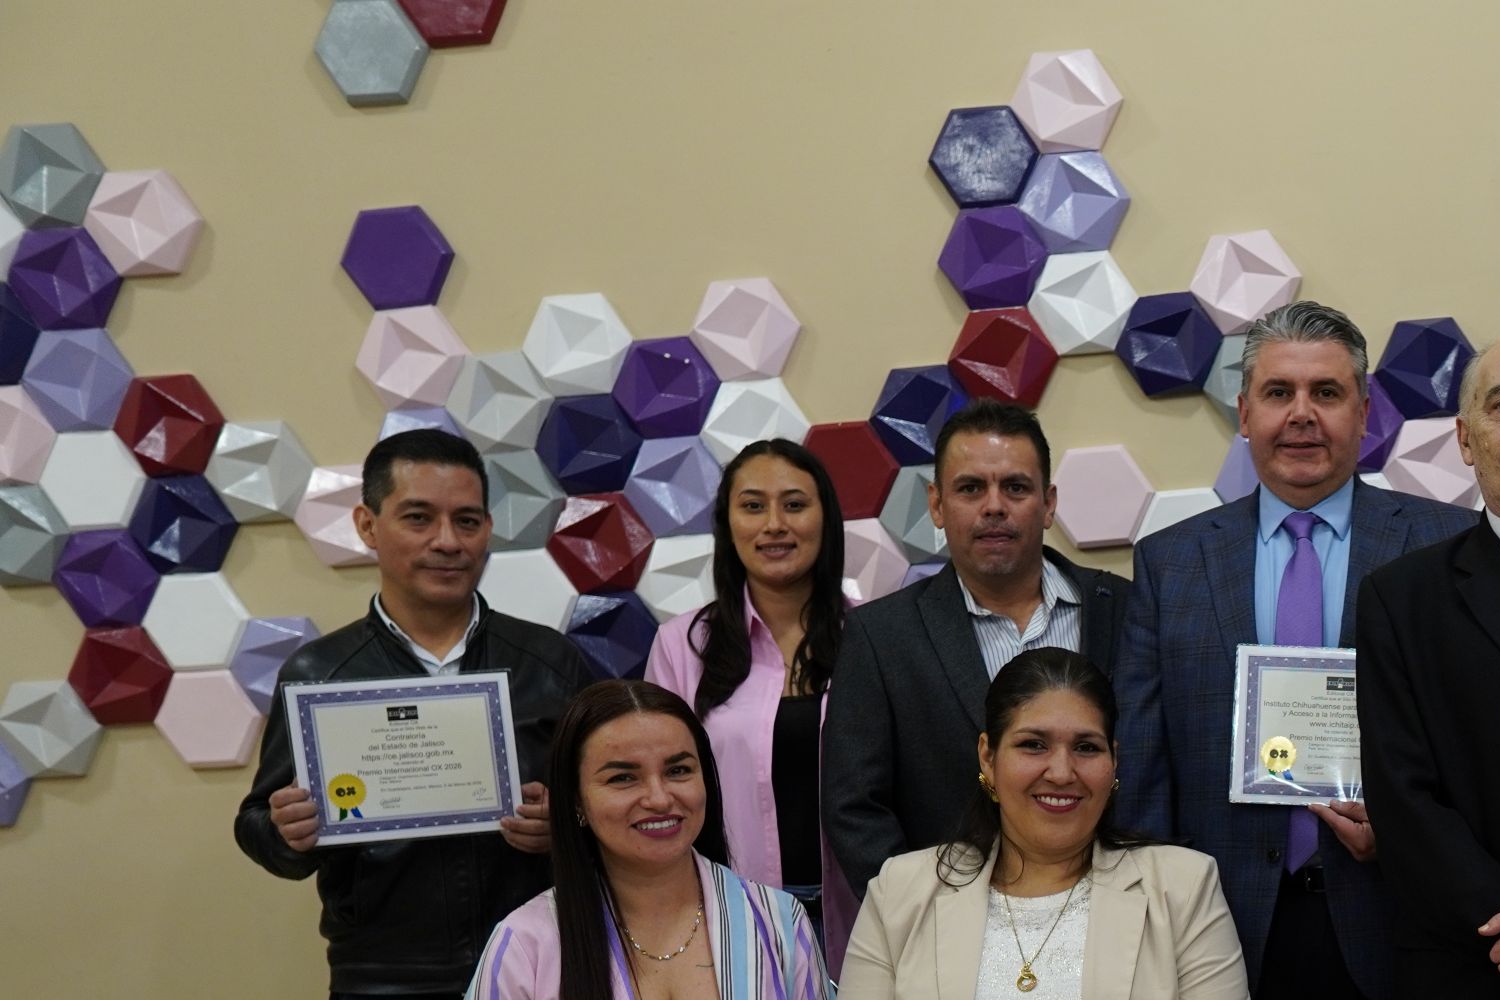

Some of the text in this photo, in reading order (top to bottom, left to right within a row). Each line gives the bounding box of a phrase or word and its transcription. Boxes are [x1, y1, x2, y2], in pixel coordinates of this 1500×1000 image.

[1292, 702, 1340, 710] Chihuahuense
[1315, 735, 1356, 743] Internacional
[382, 742, 407, 750] Estado
[357, 769, 382, 777] Premio
[384, 765, 429, 775] Internacional
[444, 762, 462, 770] 2026
